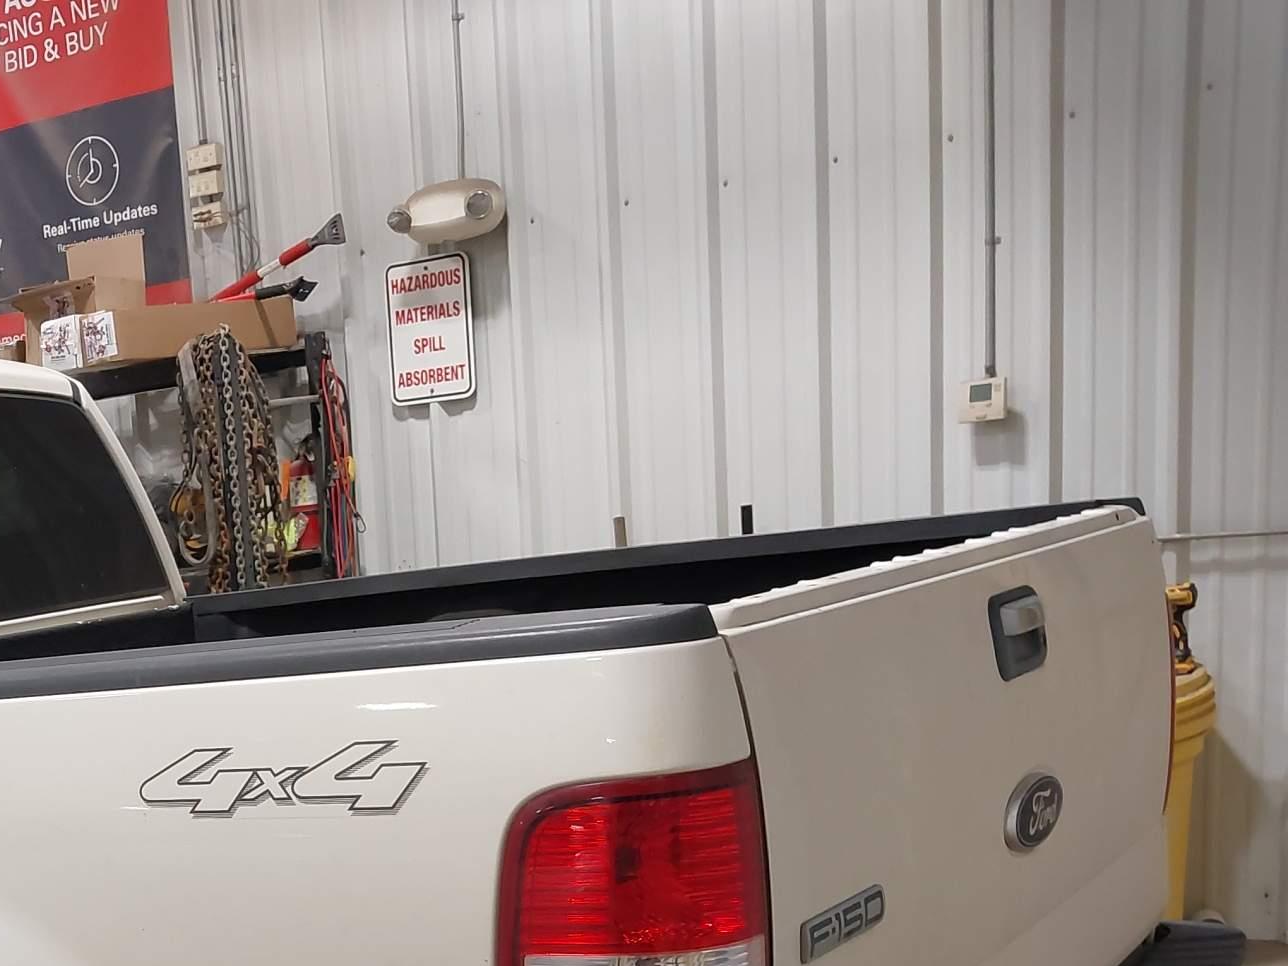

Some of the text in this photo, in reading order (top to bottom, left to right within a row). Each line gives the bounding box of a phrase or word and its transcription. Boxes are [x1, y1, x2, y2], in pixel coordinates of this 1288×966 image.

[49, 6, 66, 31] A
[70, 0, 119, 24] NEW
[5, 45, 38, 73] BID
[43, 38, 61, 62] &
[65, 22, 108, 56] BUY
[42, 203, 159, 239] Real-Time Updates
[390, 267, 461, 295] HAZARDOUS
[395, 300, 461, 326] MATERIALS
[413, 336, 446, 355] SPILL
[397, 364, 466, 389] ABSORBENT
[138, 739, 430, 819] 4x4
[1029, 788, 1059, 836] Ford
